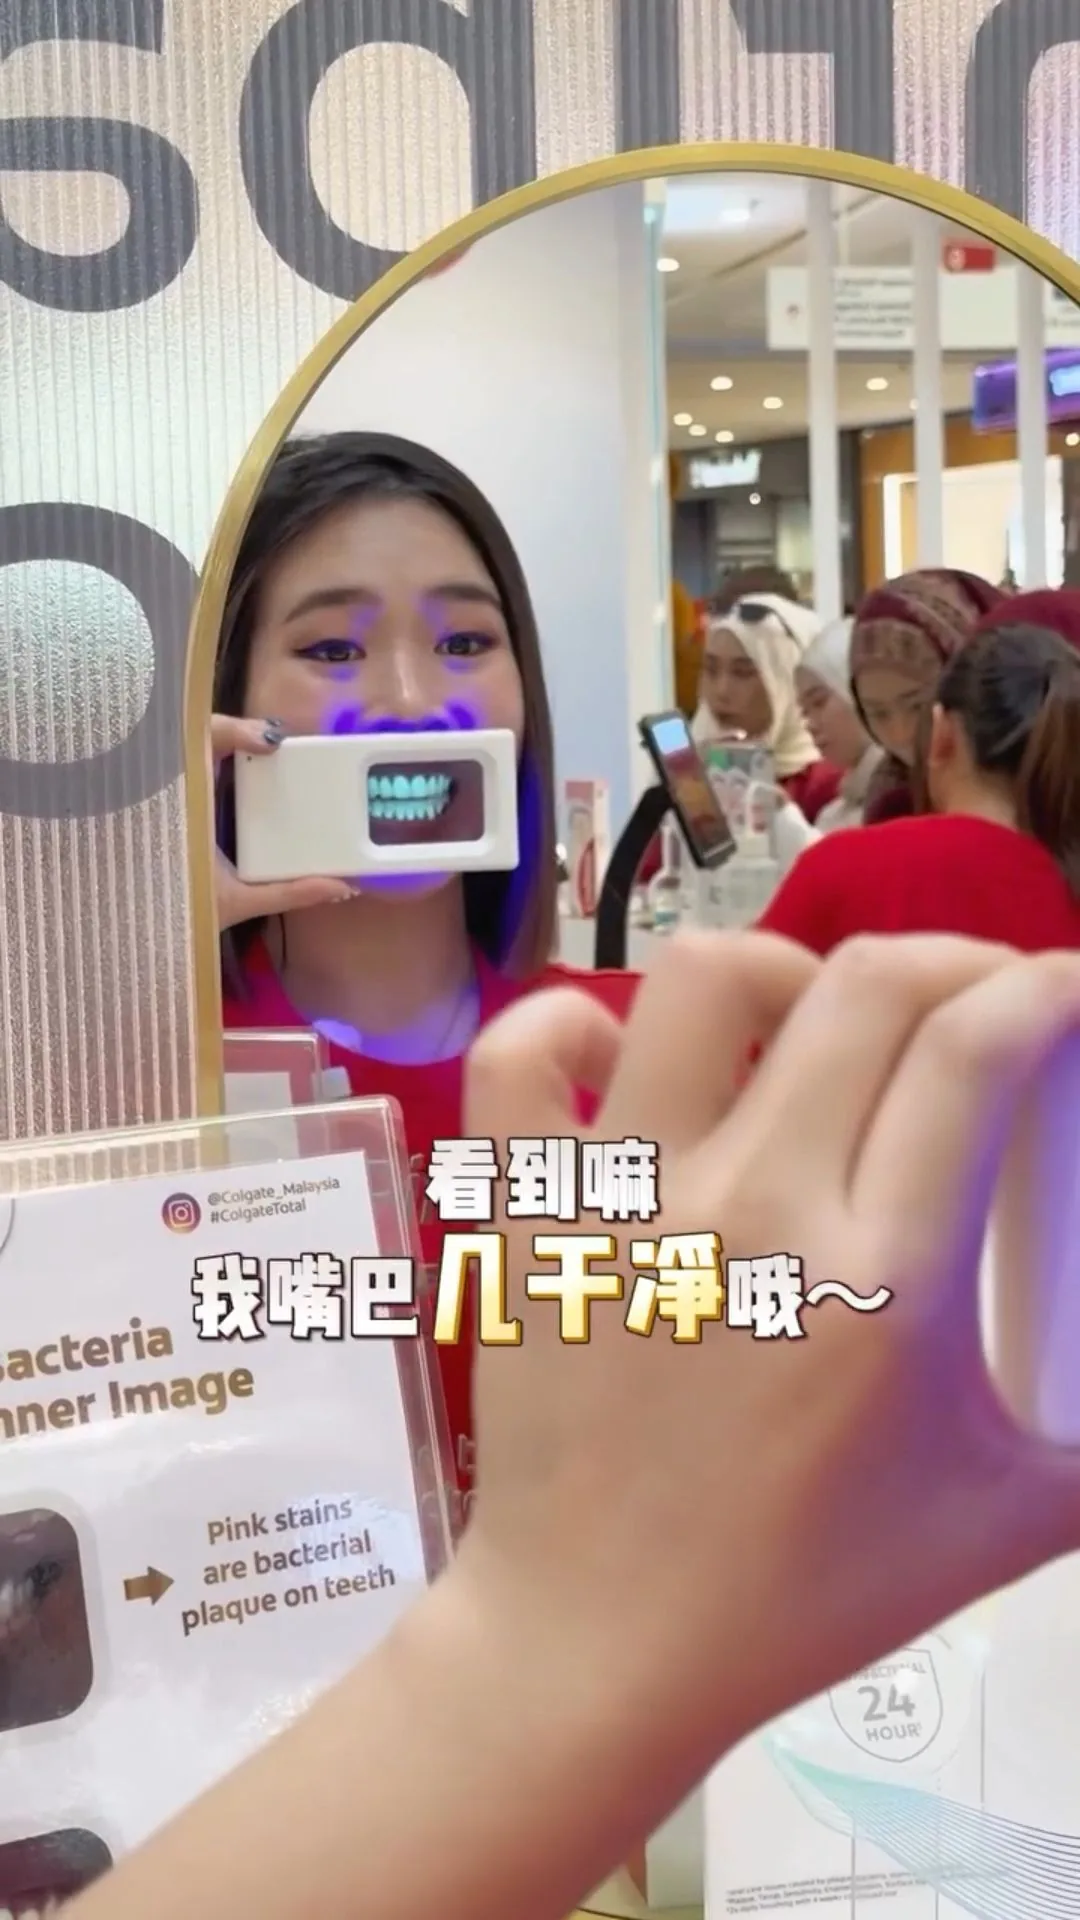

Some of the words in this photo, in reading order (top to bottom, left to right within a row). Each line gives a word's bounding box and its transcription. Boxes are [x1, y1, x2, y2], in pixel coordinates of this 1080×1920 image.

[207, 1176, 341, 1206] @Colgate_Malaysia
[210, 1198, 307, 1224] #ColgateTotal
[0, 1316, 174, 1385] acteria
[108, 1367, 254, 1419] Image
[207, 1512, 269, 1546] Pink
[274, 1499, 353, 1533] stains
[203, 1559, 248, 1586] are
[253, 1529, 373, 1576] bacterial
[181, 1592, 278, 1638] plaque
[283, 1582, 319, 1608] on
[324, 1563, 397, 1601] teeth
[857, 1683, 916, 1722] 24
